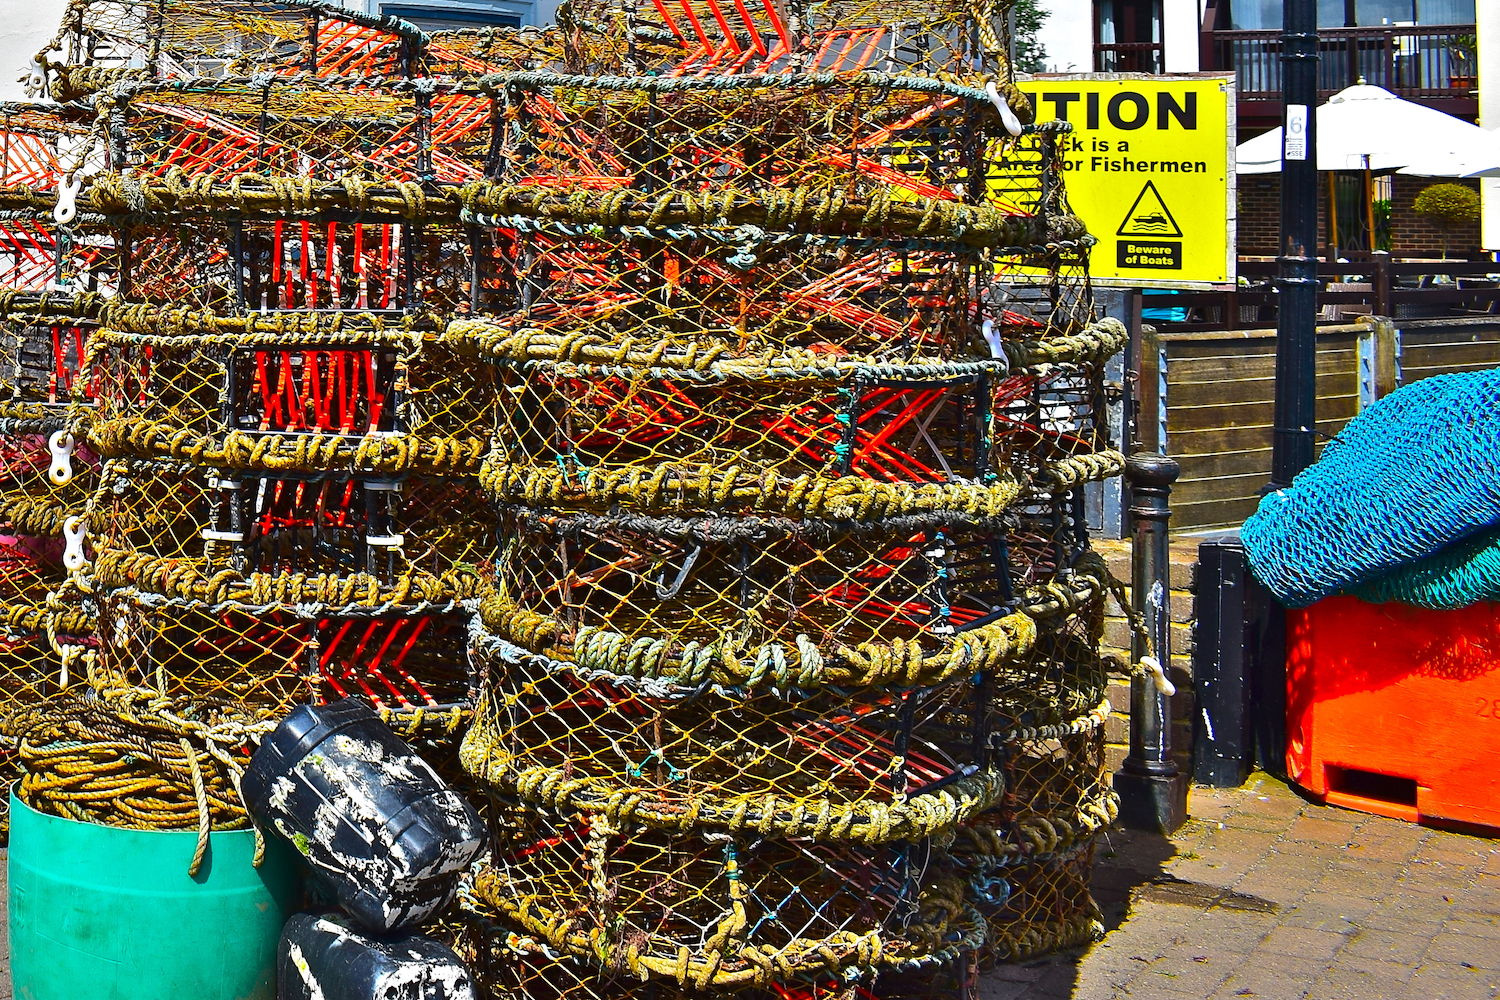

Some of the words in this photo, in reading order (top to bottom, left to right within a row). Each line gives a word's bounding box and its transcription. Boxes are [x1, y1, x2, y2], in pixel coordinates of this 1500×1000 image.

[1290, 116, 1302, 134] 6
[1092, 137, 1109, 152] is
[1117, 141, 1129, 152] a
[1091, 157, 1207, 173] Fishermen
[1127, 244, 1172, 254] Beware
[1125, 255, 1138, 264] of
[1140, 255, 1174, 266] Boats
